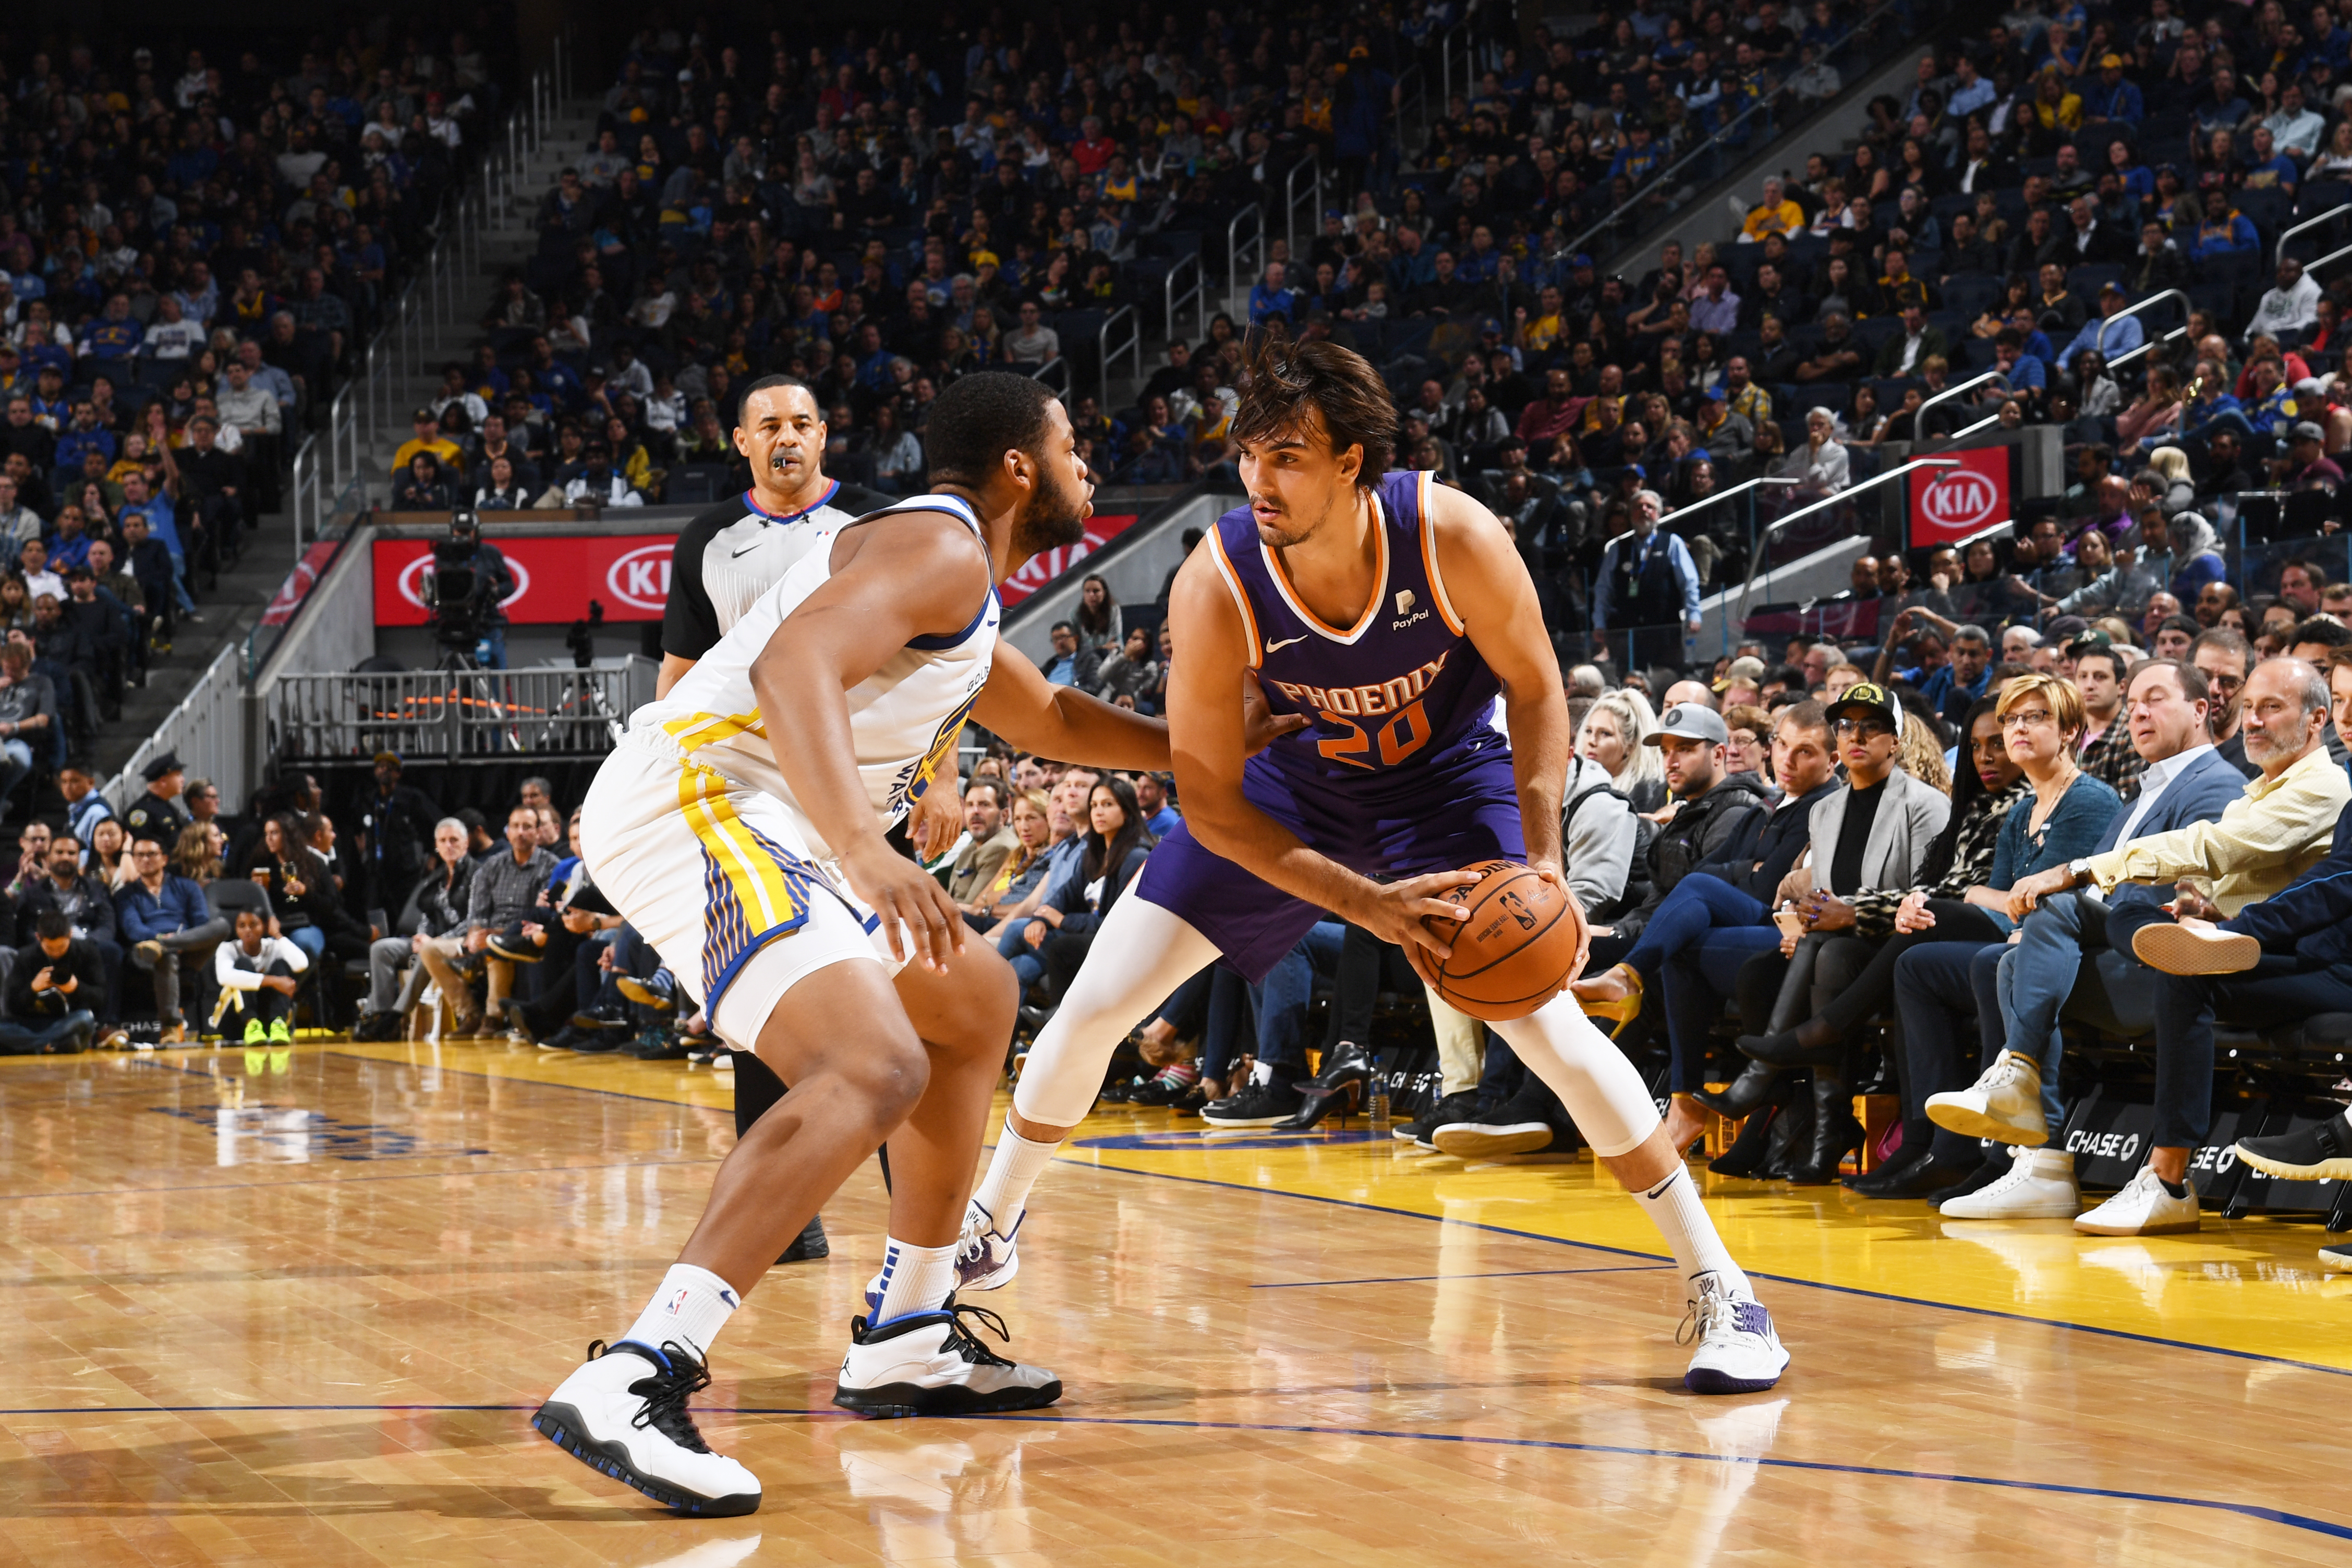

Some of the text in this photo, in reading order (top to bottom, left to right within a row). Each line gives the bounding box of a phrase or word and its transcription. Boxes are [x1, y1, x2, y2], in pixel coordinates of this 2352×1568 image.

[1935, 482, 1984, 515] KIA
[628, 560, 672, 595] KI
[1392, 609, 1429, 631] PayPal
[1269, 650, 1450, 716] PHOENIX
[1317, 698, 1432, 770] 20
[2066, 1129, 2125, 1157] CHASE
